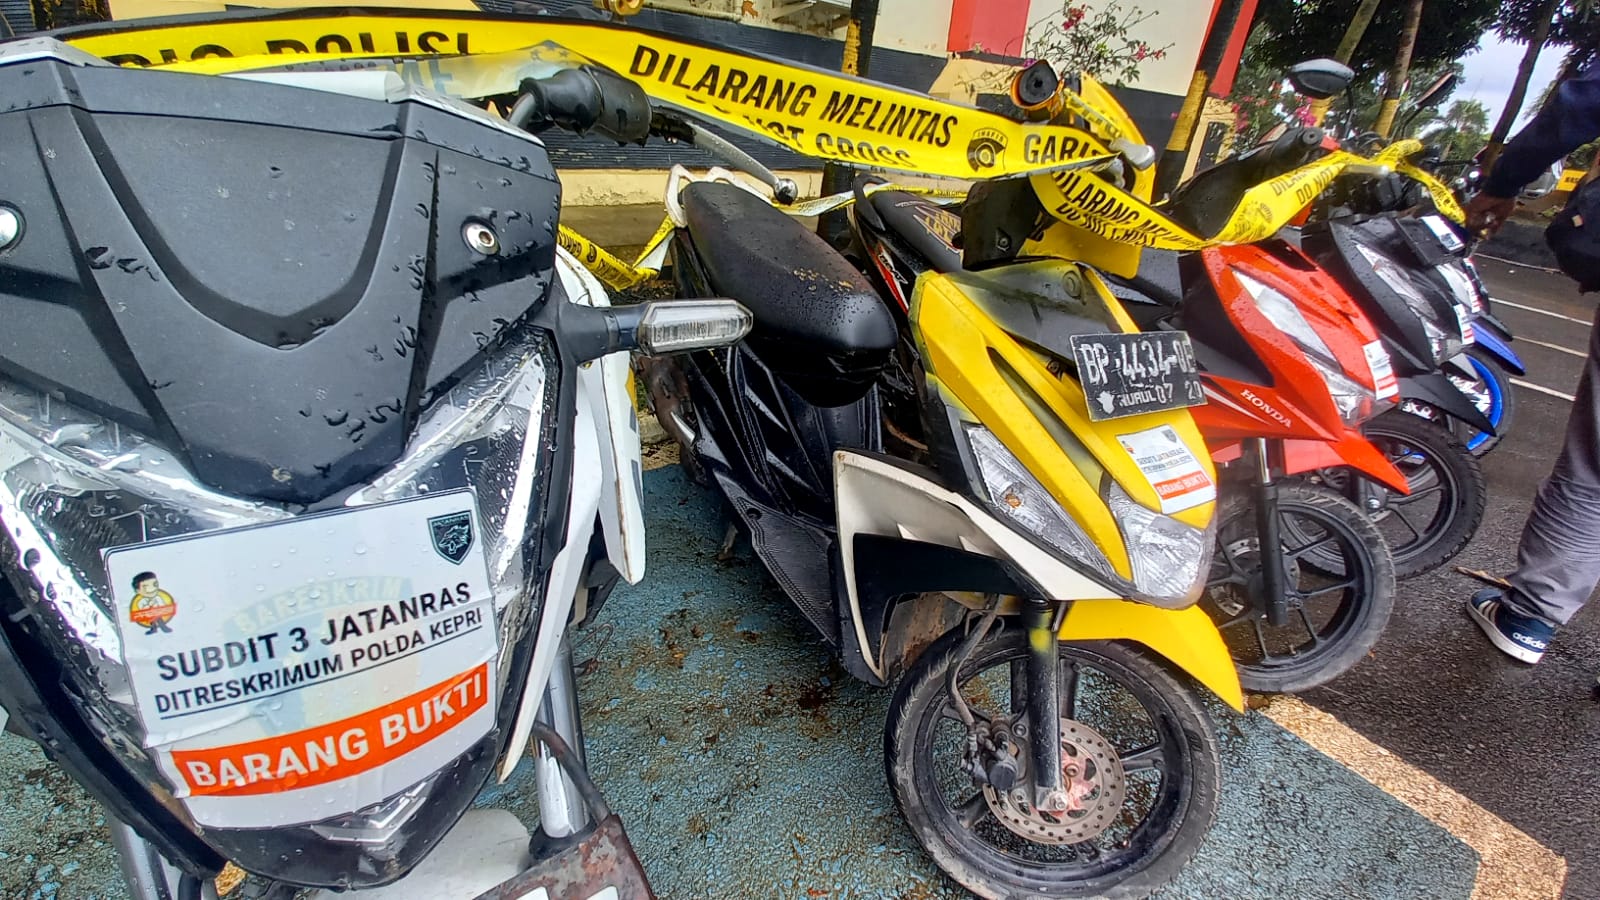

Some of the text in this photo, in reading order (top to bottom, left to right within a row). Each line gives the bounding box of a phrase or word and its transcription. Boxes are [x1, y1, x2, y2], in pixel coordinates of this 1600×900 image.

[629, 44, 959, 149] DILARANG MELINTAS
[1295, 166, 1335, 205] DO NOT
[1079, 343, 1109, 386] BP
[1121, 341, 1172, 381] 4434
[1184, 381, 1202, 400] 20
[1241, 389, 1291, 428] HONDA
[157, 582, 471, 681] SUBDIT 3 JATANRAS
[1512, 632, 1546, 649] adida
[155, 608, 482, 714] DITRESKRIMUM POLDA KEPRI
[186, 671, 483, 787] BARANG BUKTI
